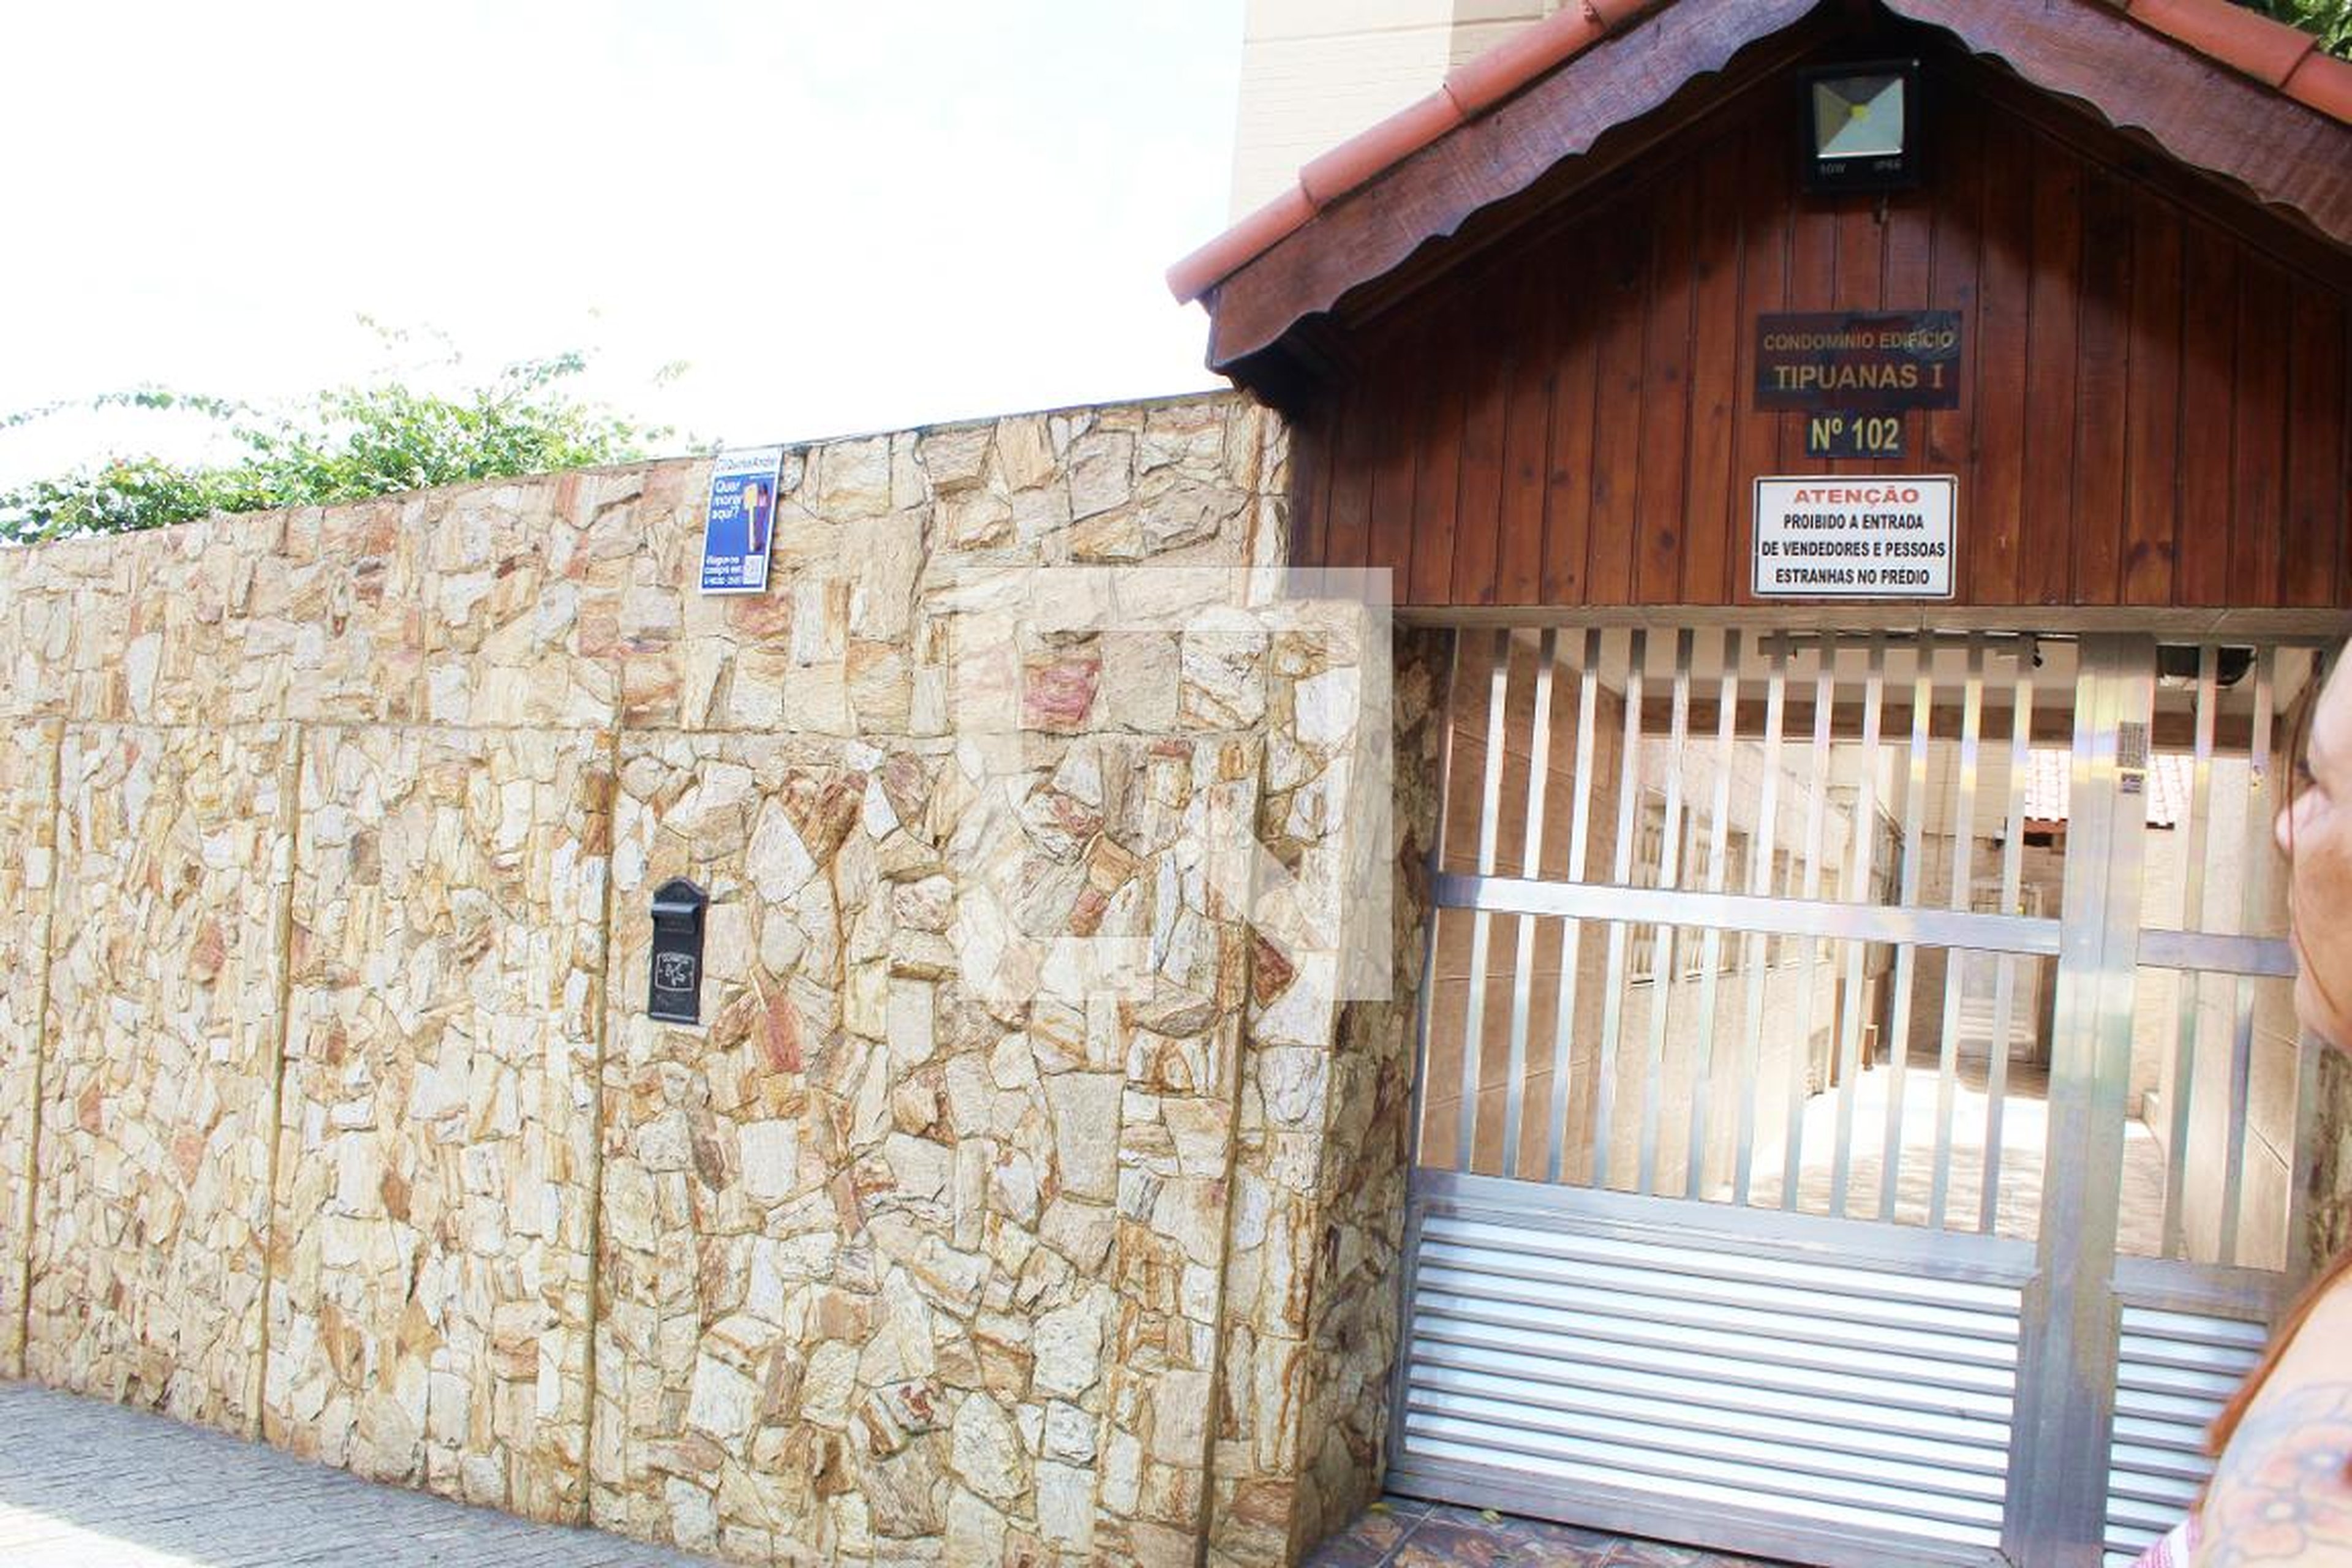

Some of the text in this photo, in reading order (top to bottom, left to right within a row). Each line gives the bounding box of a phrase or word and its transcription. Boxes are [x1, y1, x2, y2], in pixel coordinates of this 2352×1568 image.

[1775, 364, 1943, 390] TIPUANAS I
[1852, 417, 1898, 450] 102
[1794, 486, 1920, 507] ATENÇÃO
[1784, 514, 1924, 529] PROIBIDO A ENTRADA
[1762, 541, 1945, 557] DE VENDEDORES E PESSOAS
[1776, 568, 1855, 585] ESTRANHAS
[1858, 569, 1877, 584] NO
